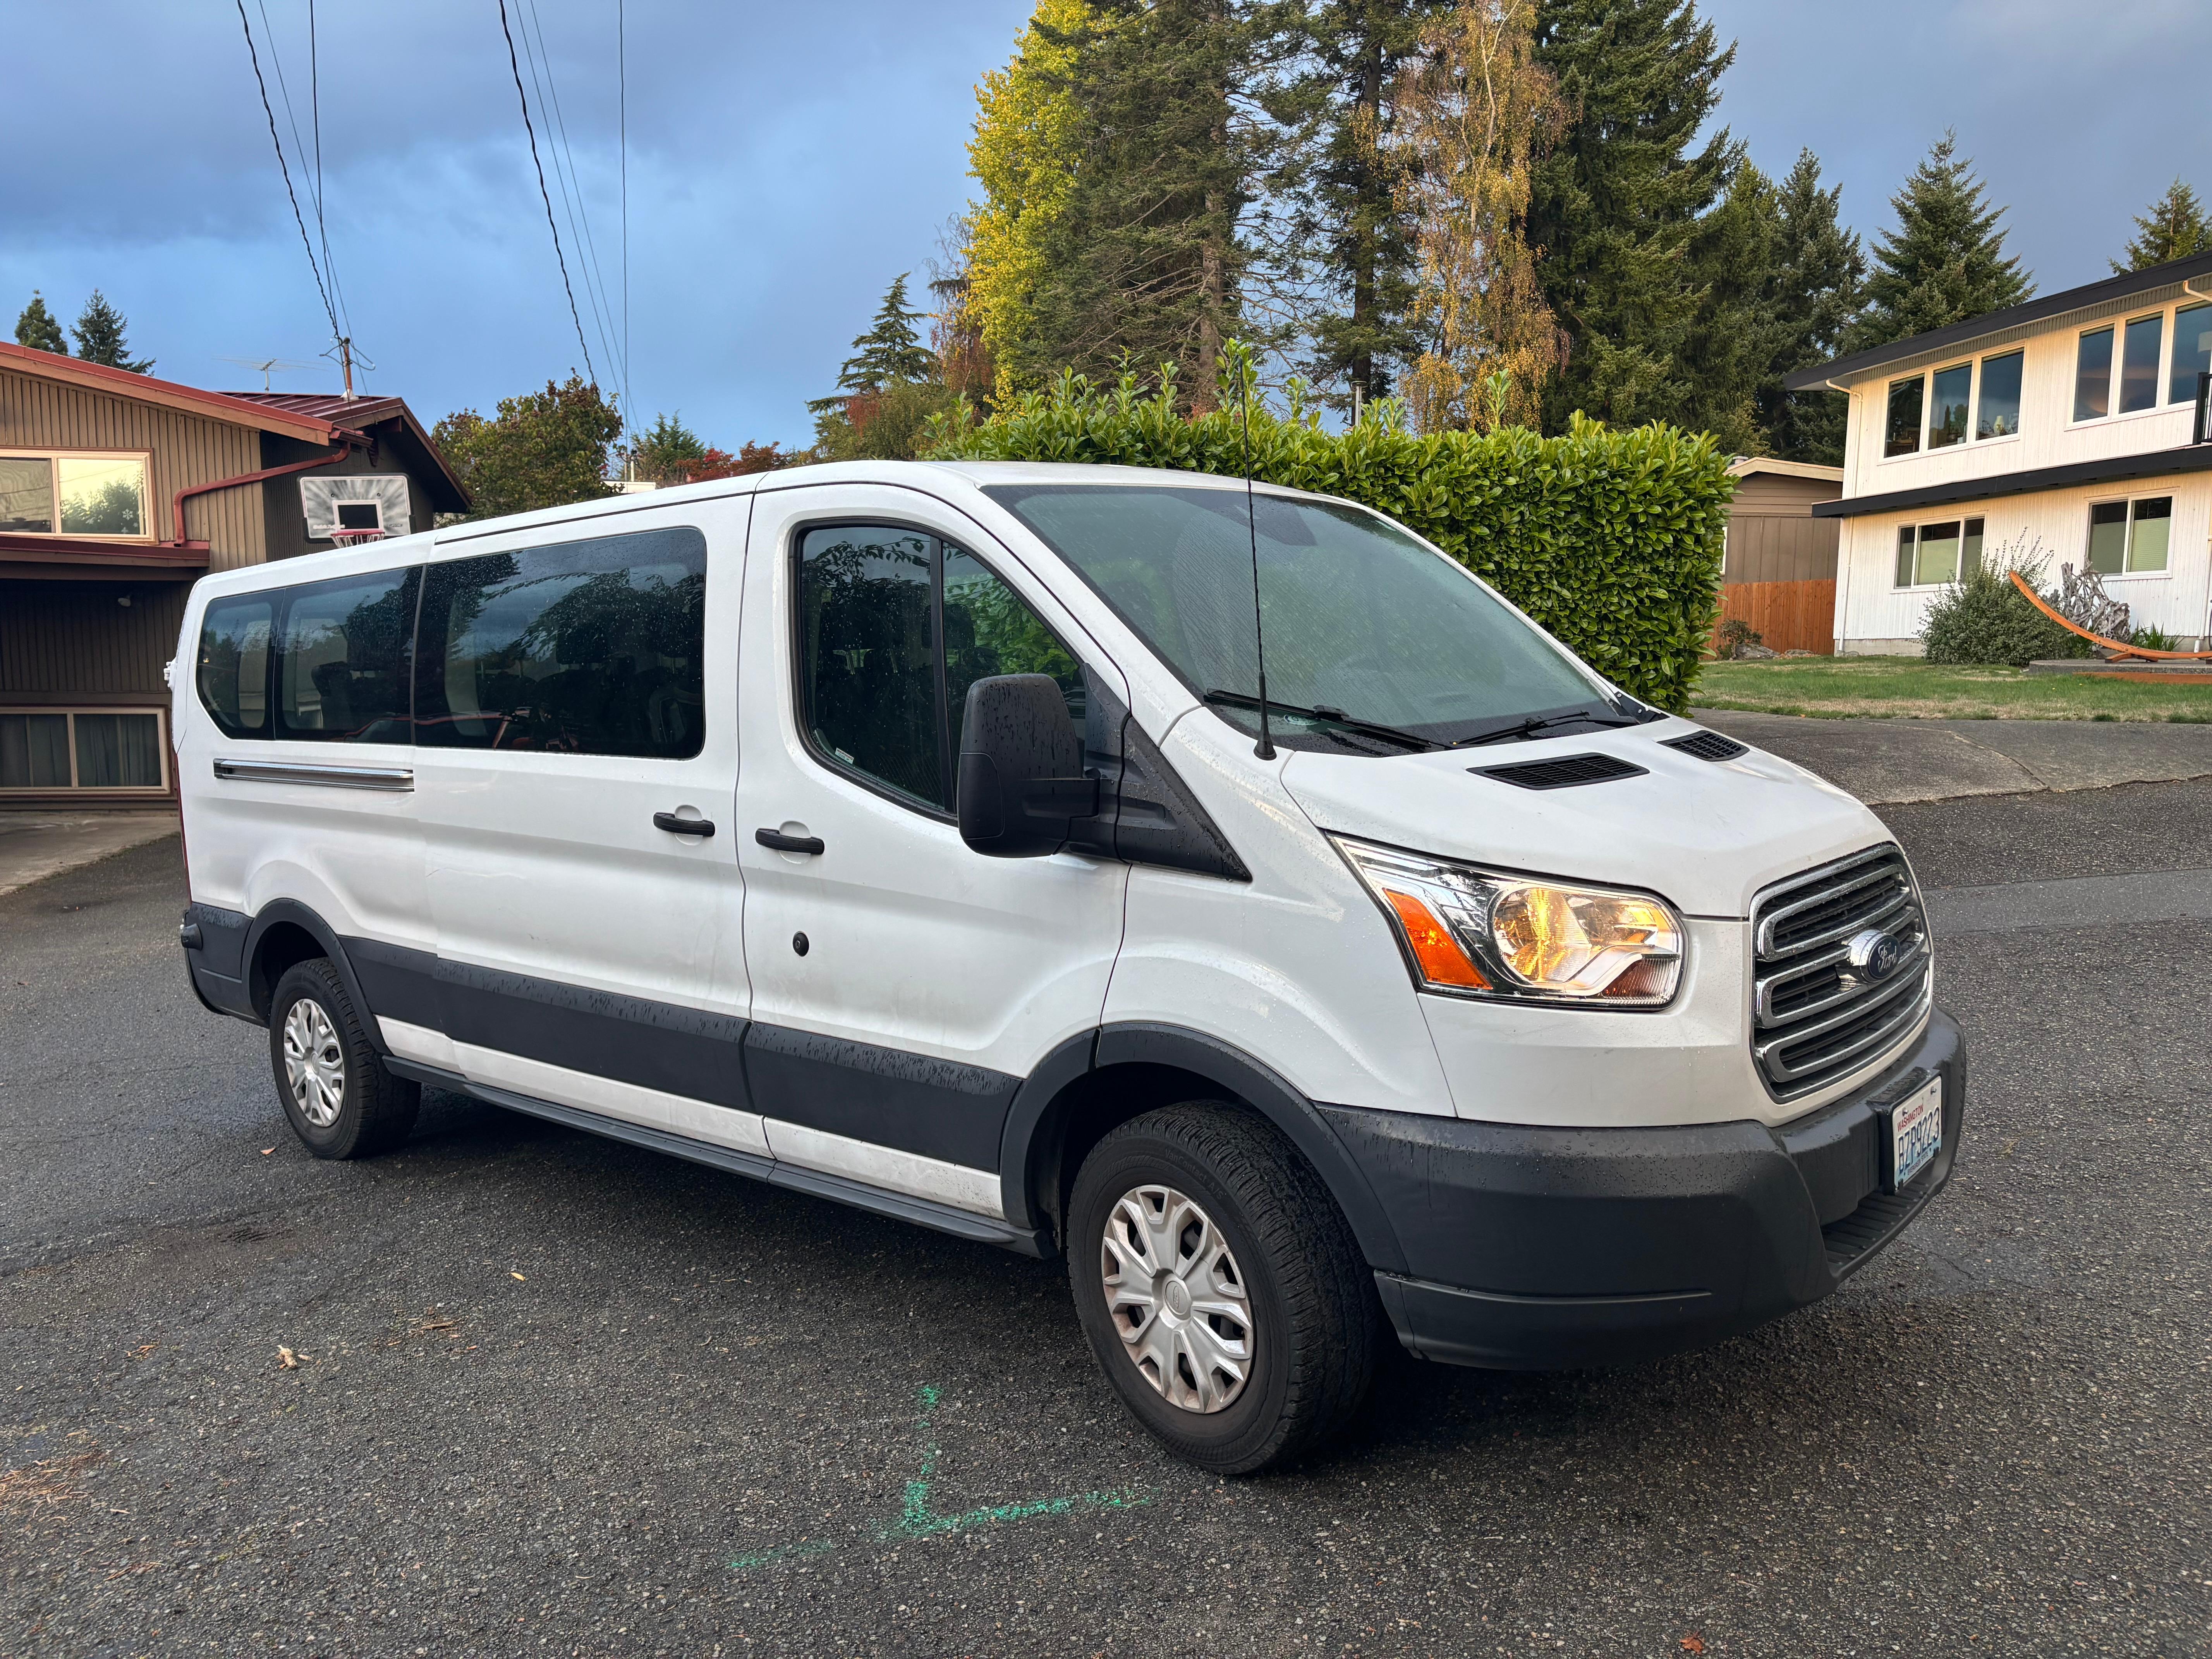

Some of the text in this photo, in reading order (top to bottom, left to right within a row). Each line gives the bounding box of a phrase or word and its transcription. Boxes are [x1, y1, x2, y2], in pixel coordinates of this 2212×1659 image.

[1878, 942, 1897, 972] Ford
[1898, 1104, 1923, 1132] WASHINGTON
[1899, 1106, 1939, 1174] BZP9223
[1165, 1148, 1223, 1199] VanContact A/S
